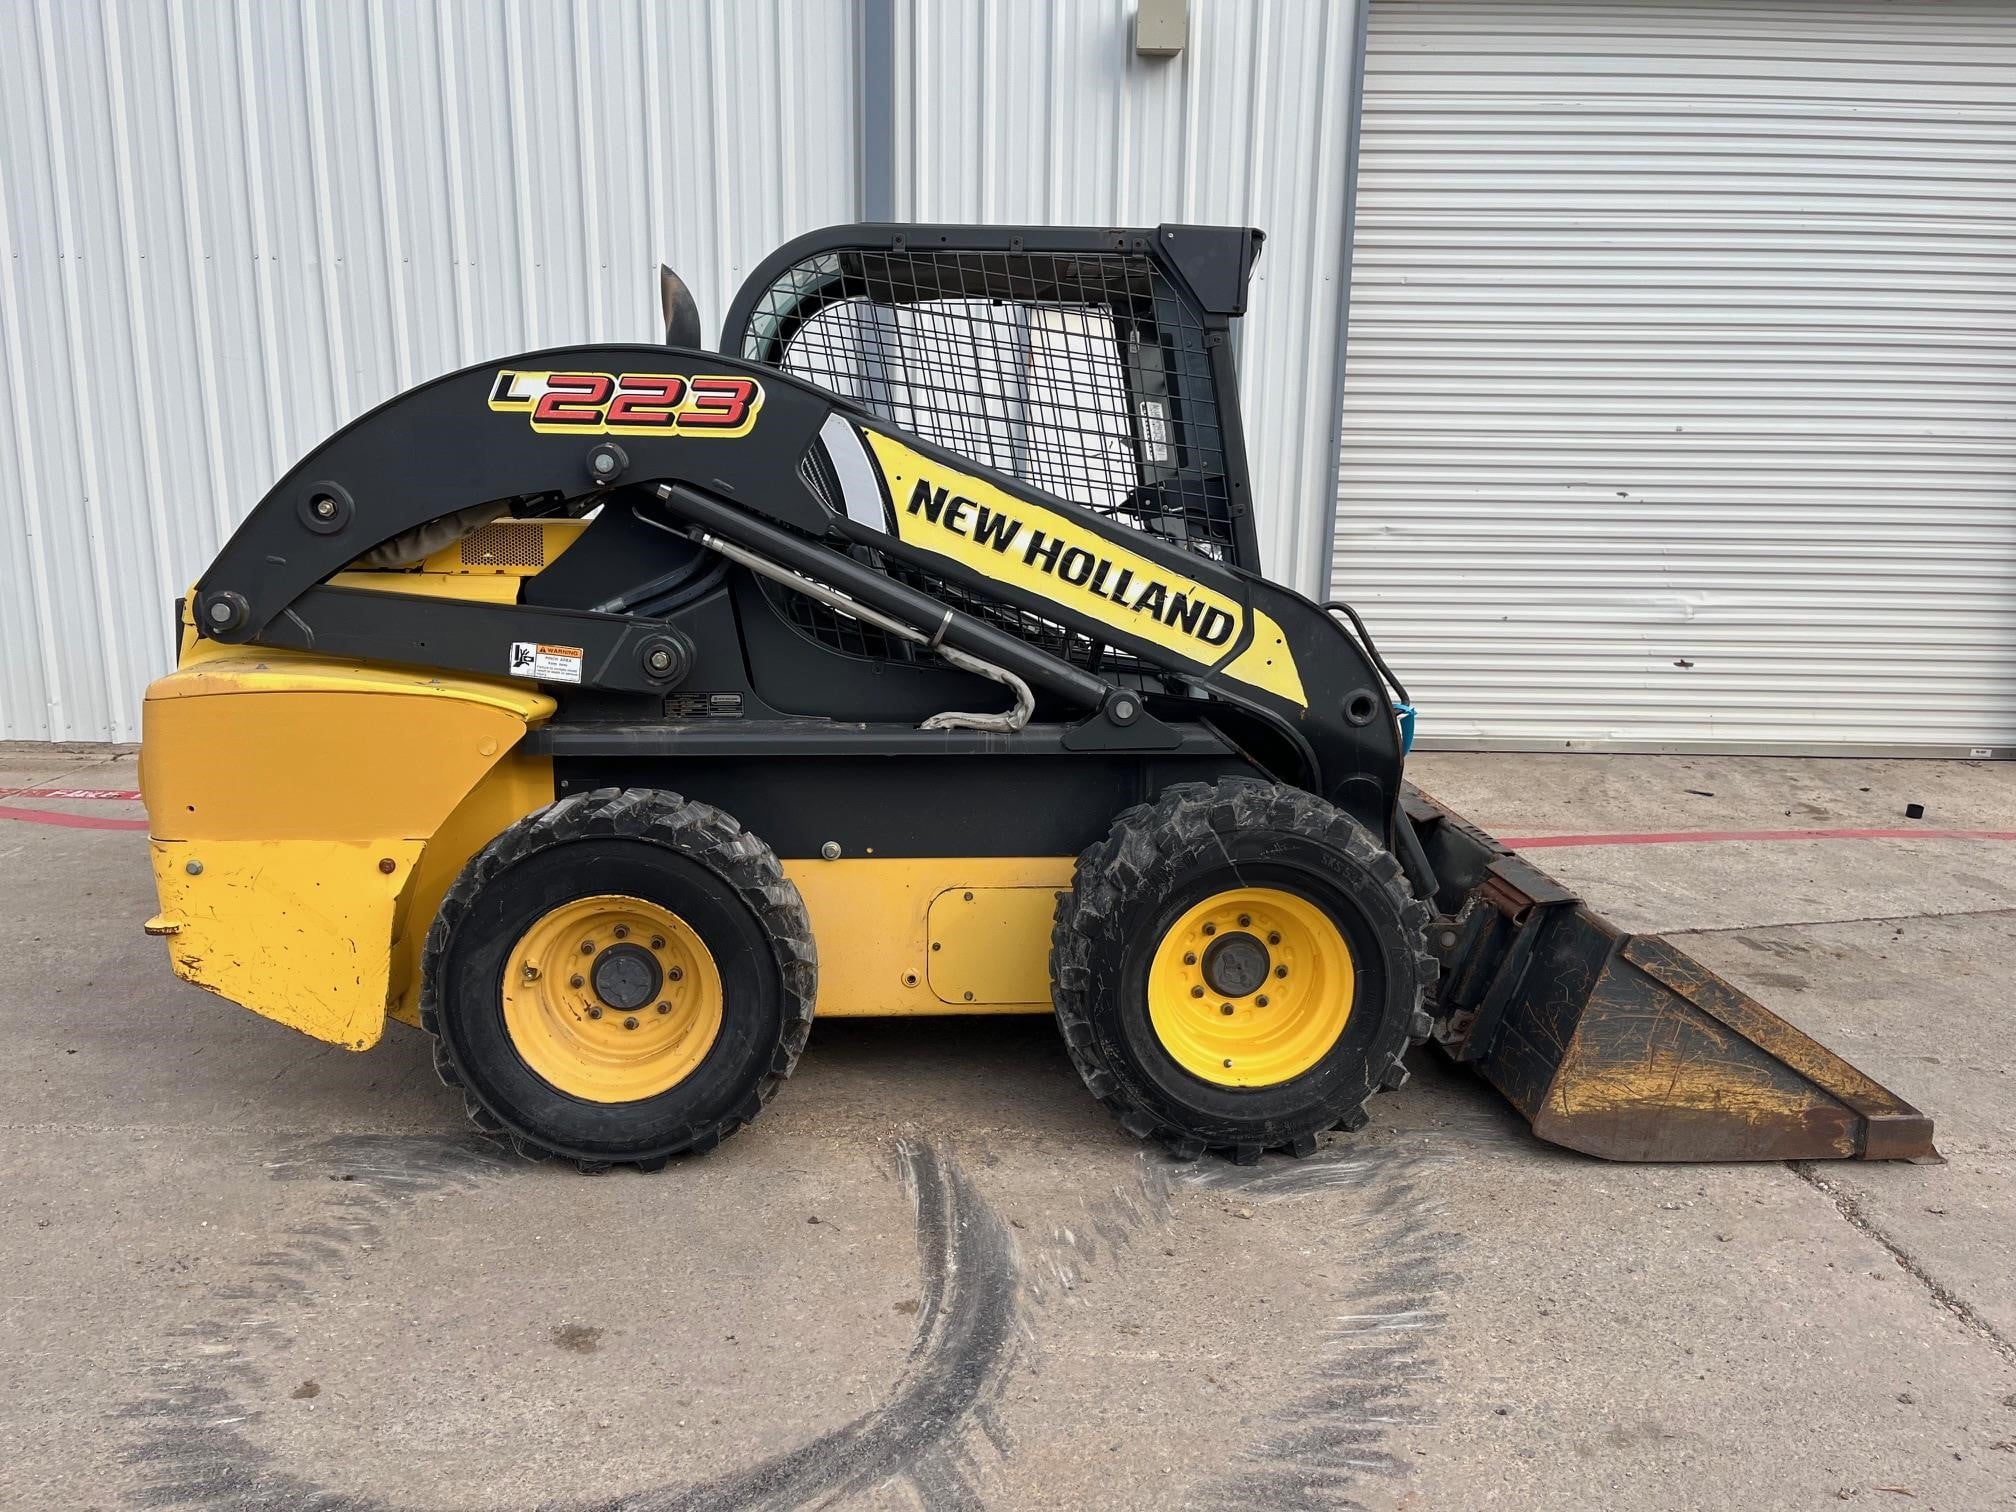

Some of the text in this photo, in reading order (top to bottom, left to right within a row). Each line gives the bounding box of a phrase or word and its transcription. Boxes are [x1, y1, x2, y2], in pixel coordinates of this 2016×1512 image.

[490, 374, 759, 427] L223
[907, 478, 1235, 647] NEW HOLLAND
[547, 647, 578, 656] WARNING
